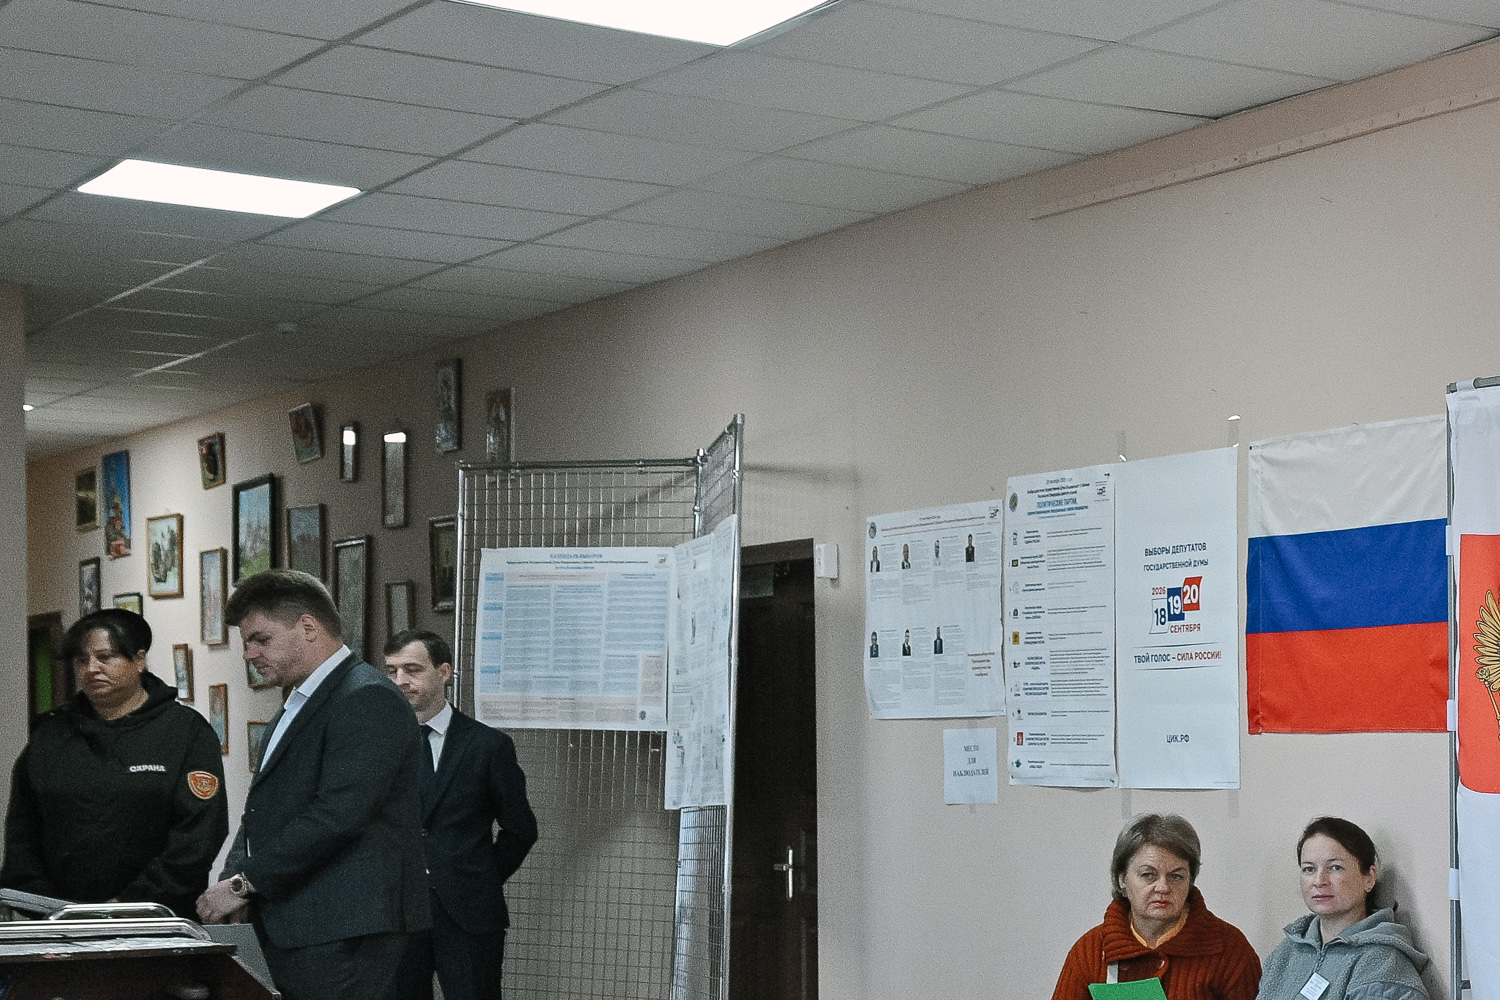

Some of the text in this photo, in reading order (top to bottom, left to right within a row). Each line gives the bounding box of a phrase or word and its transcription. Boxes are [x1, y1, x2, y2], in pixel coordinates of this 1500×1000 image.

[1144, 542, 1207, 557] ВЫБОРЫ ДЕПУТАТОВ
[1143, 559, 1209, 572] ГОСУДАРСТВЕННОЙ ДУМЫ
[1151, 586, 1167, 595] 2026
[1154, 584, 1199, 626] 18 19 20
[1169, 623, 1201, 634] СЕНТЯБРЯ
[1134, 652, 1149, 664] ТВОЙ
[1150, 653, 1171, 663] ГОЛОС
[1177, 652, 1194, 661] СИЛА
[1194, 651, 1222, 660] РОССИИ!
[1166, 734, 1190, 744] ЦИК.РФ
[129, 764, 166, 772] ОХРАНА
